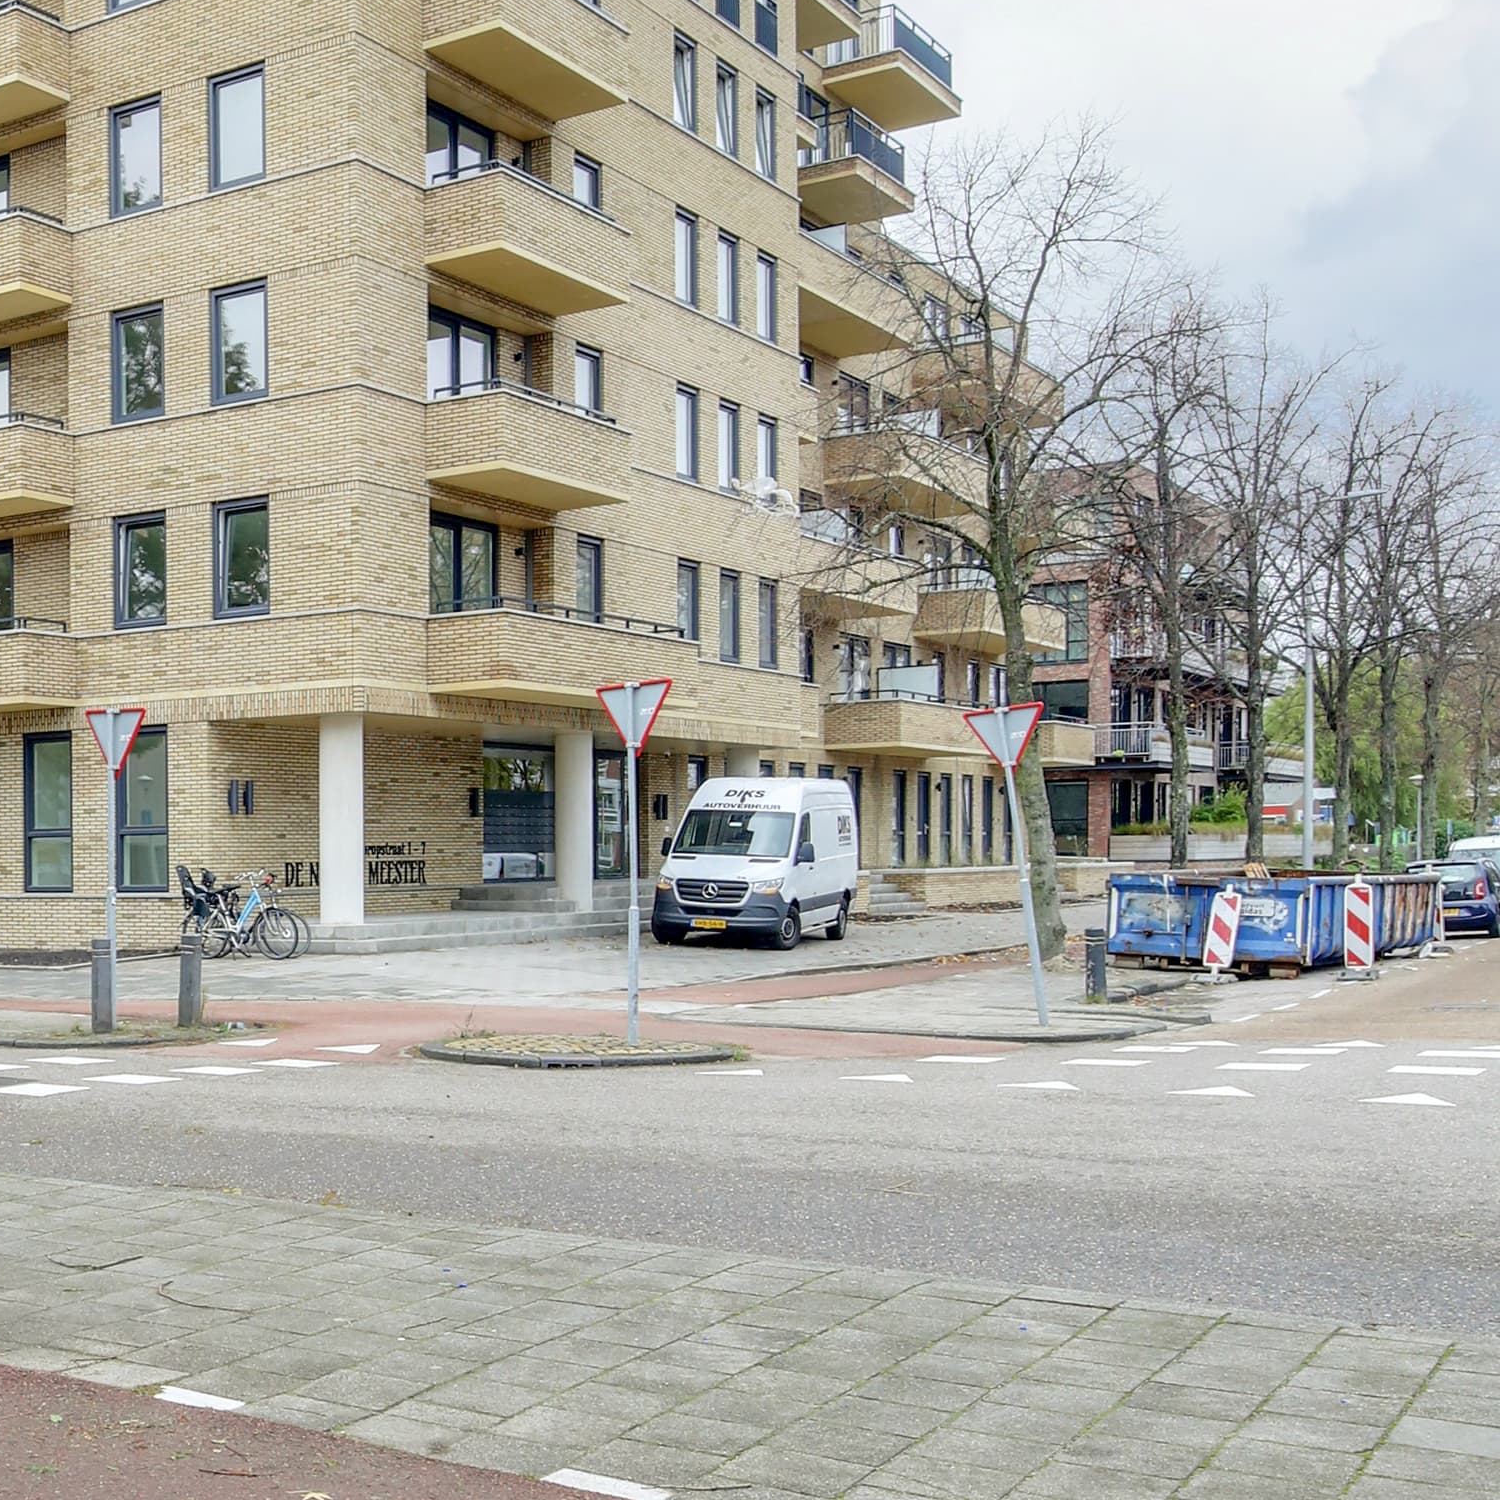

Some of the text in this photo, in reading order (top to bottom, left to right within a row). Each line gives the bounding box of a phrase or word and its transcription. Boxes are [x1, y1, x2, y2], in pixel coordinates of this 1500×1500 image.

[724, 789, 766, 802] DIKS
[702, 802, 781, 810] AUTOVERHUUR
[420, 841, 426, 855] 7
[285, 861, 304, 887] DE
[368, 859, 426, 885] MEESTER
